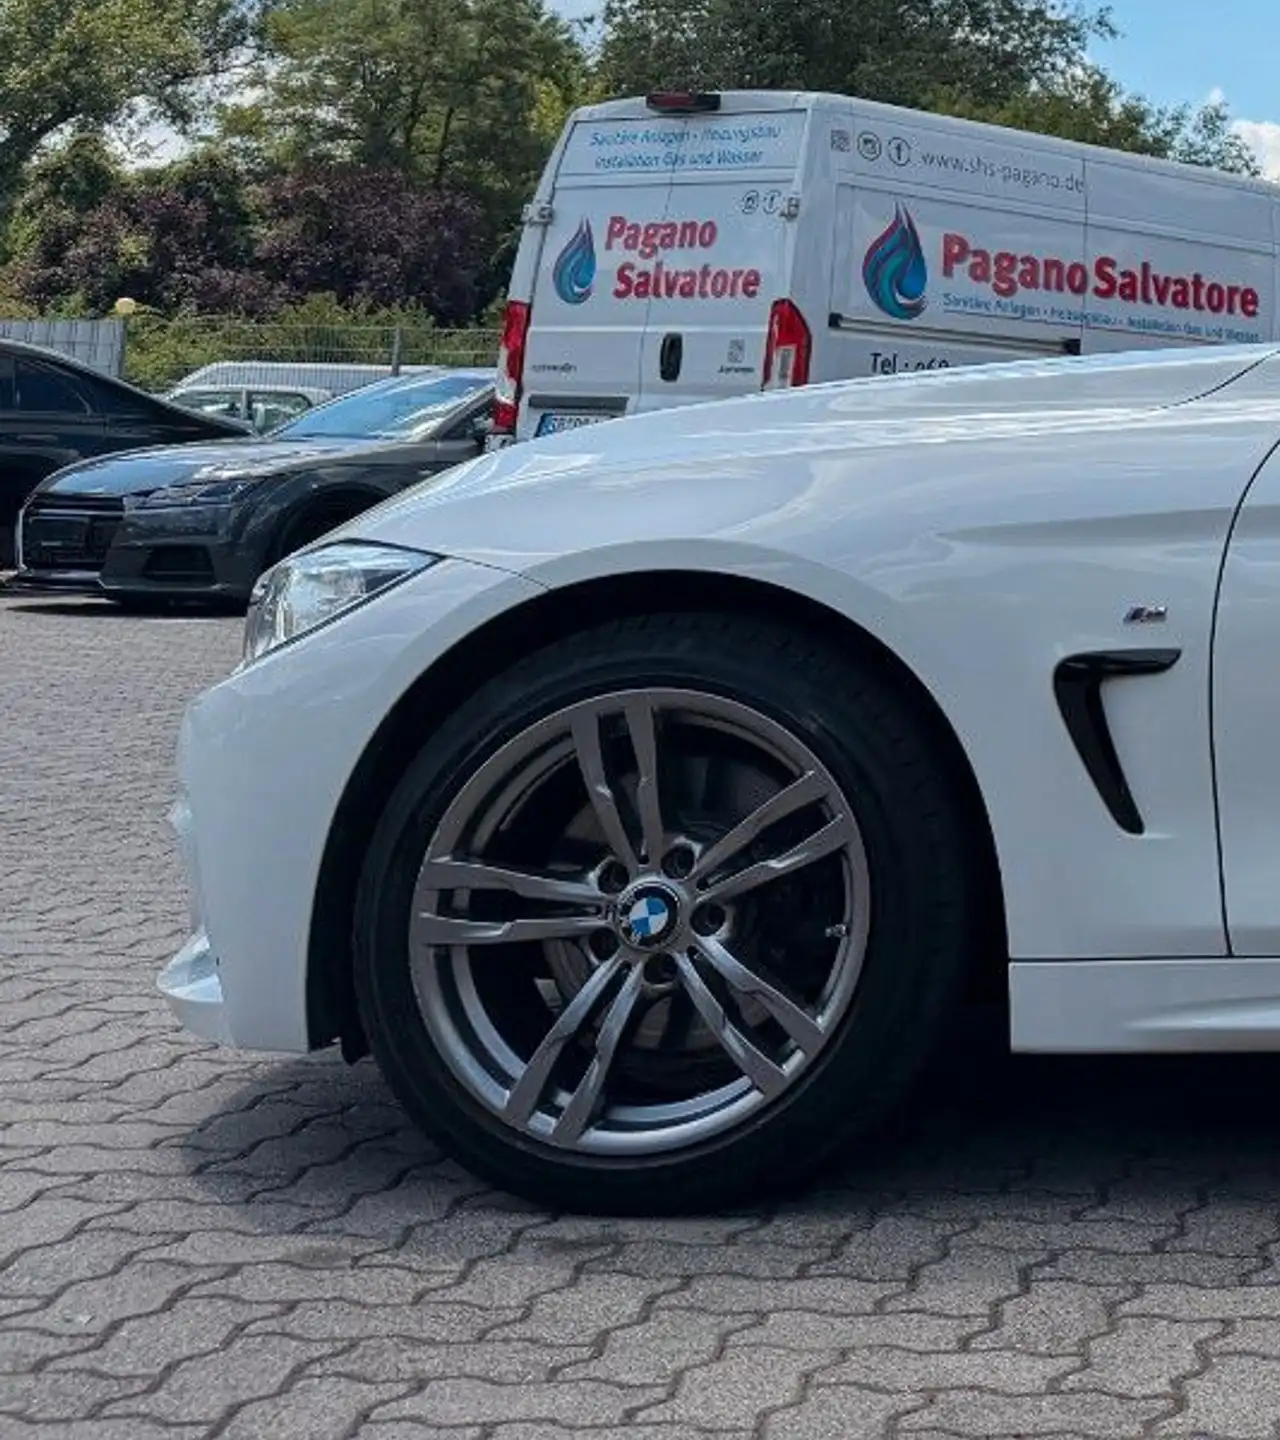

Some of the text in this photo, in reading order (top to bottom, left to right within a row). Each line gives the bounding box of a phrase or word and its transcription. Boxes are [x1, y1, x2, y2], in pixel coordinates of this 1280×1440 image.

[920, 149, 1084, 194] www.shs-pagano.de
[605, 215, 718, 259] Pagano
[612, 261, 761, 299] Salvatore
